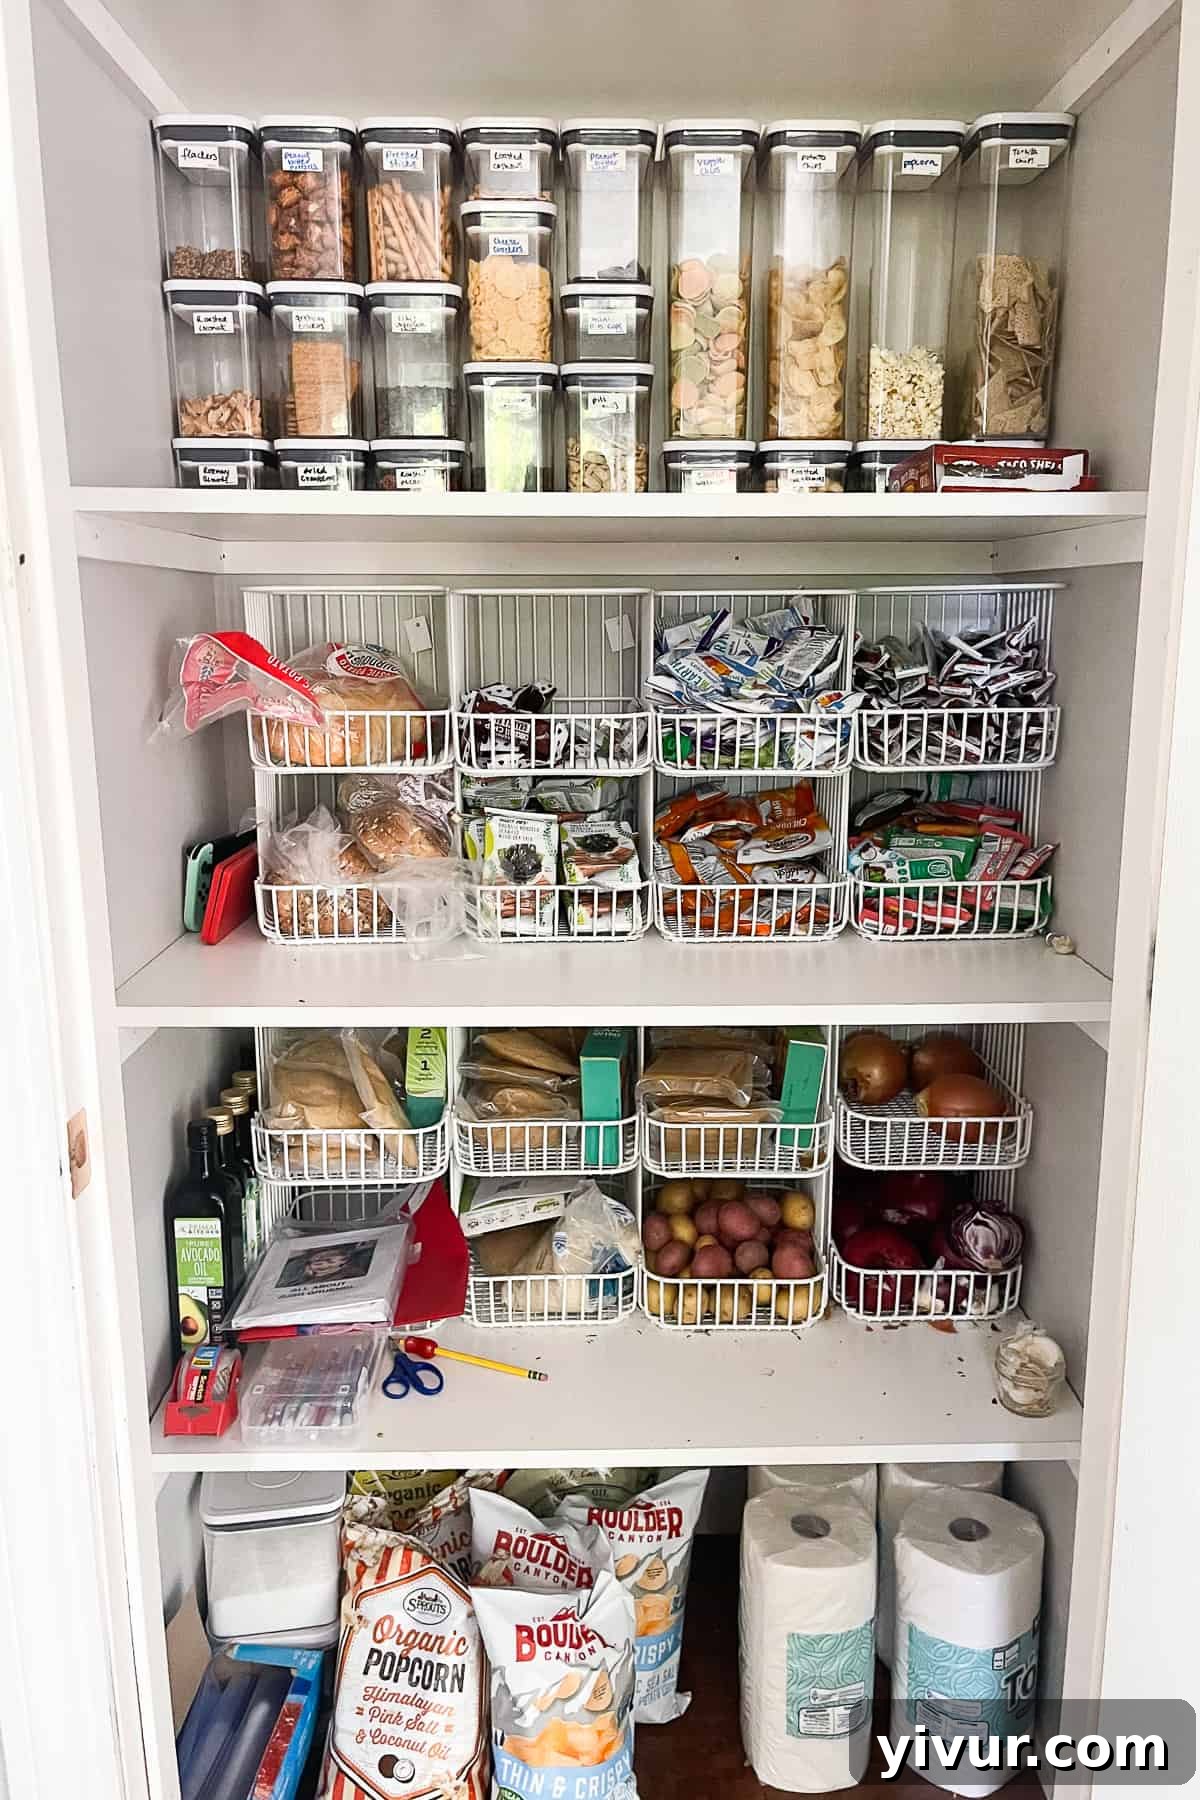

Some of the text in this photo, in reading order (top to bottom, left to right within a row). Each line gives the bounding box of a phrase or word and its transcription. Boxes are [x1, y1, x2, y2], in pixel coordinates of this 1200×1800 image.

[267, 655, 304, 682] POTATO
[420, 1028, 432, 1039] 2
[420, 1060, 431, 1071] 1
[181, 1247, 220, 1262] AVOCADO
[194, 1262, 208, 1276] OIL
[608, 1531, 663, 1543] CANYON
[513, 1562, 568, 1589] CANYON
[407, 1598, 447, 1614] SPROUTS
[372, 1615, 469, 1657] Organic
[516, 1622, 607, 1662] BOULDE
[544, 1645, 597, 1662] CANON
[363, 1648, 465, 1693] POPCORN
[362, 1686, 455, 1716] Himalayan
[368, 1706, 441, 1735] Pink Salt
[369, 1728, 427, 1753] Coconut
[428, 1742, 453, 1761] Oil
[502, 1757, 544, 1795] THIN
[552, 1775, 567, 1799] &
